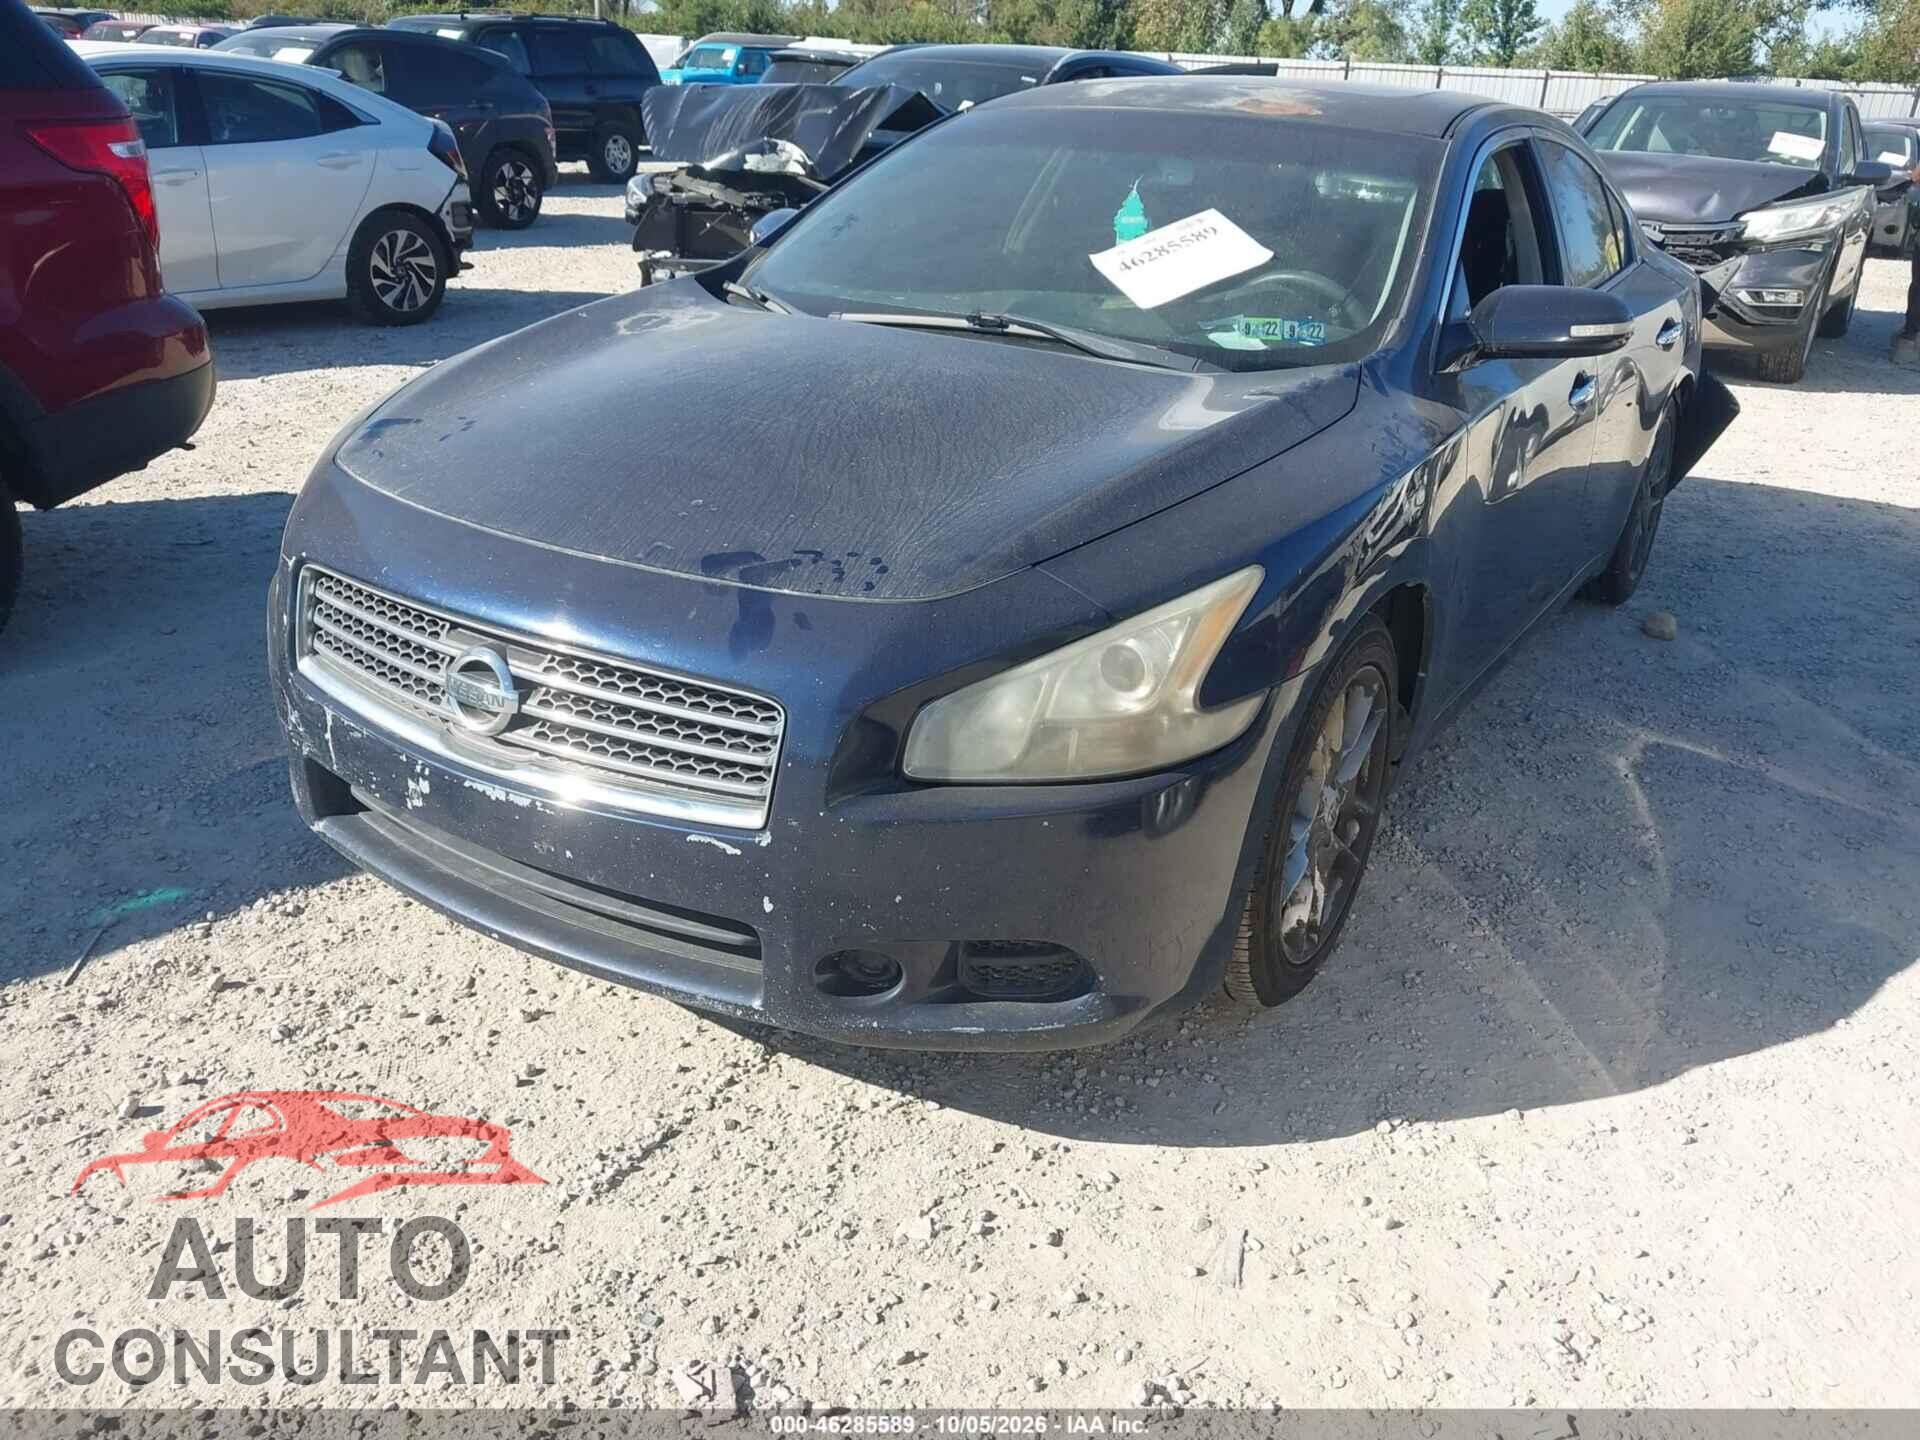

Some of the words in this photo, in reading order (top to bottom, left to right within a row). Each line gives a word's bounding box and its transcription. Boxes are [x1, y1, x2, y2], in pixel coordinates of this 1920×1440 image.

[1119, 225, 1219, 273] 46285589
[1263, 320, 1278, 336] 22
[1308, 323, 1322, 338] 22
